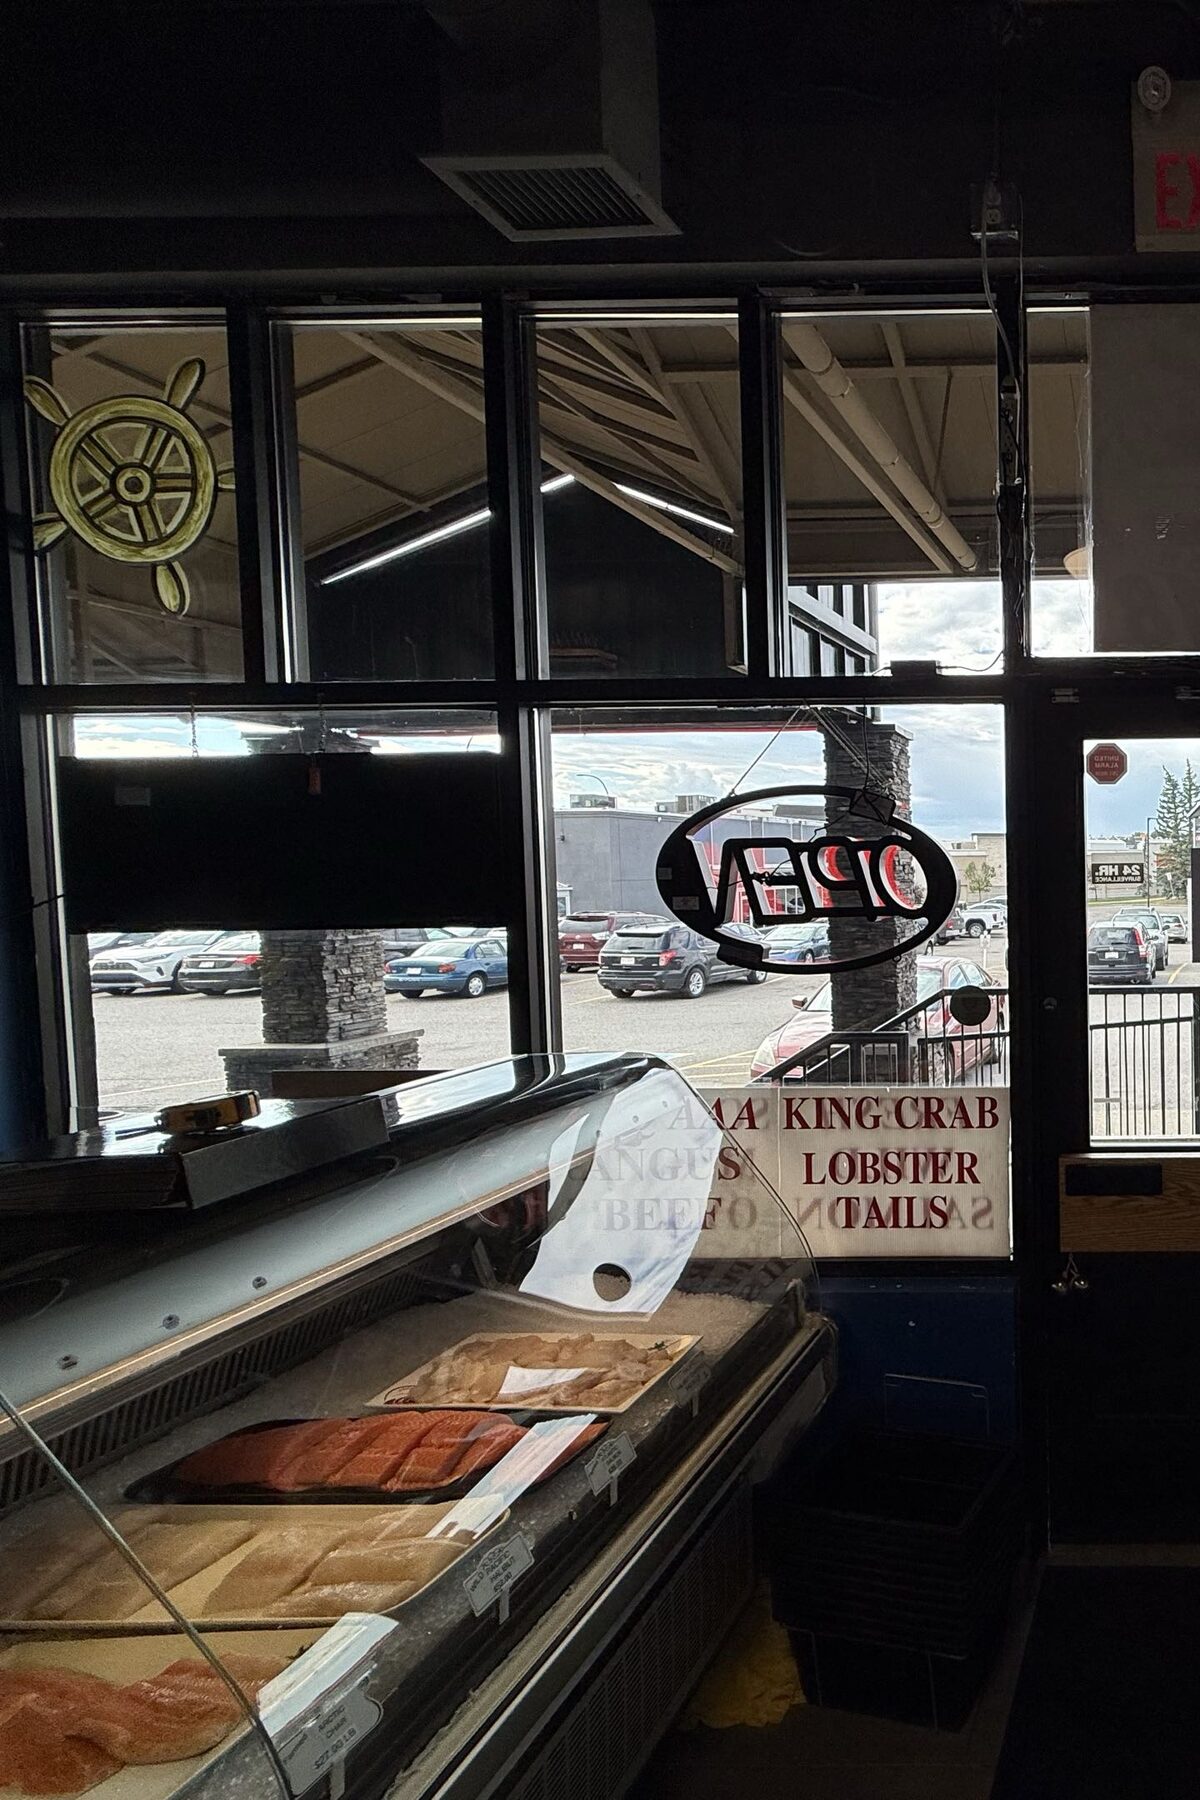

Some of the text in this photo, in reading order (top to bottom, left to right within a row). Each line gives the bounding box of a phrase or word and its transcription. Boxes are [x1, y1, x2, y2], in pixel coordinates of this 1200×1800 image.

[782, 1096, 1000, 1131] KING CRAB
[802, 1150, 981, 1185] LOBSTER
[603, 1197, 722, 1231] BEEF
[836, 1195, 949, 1230] TAILS
[470, 1571, 484, 1592] WILD
[319, 1704, 346, 1731] ARCTIC
[325, 1717, 347, 1739] CHAR
[343, 1727, 357, 1742] LB
